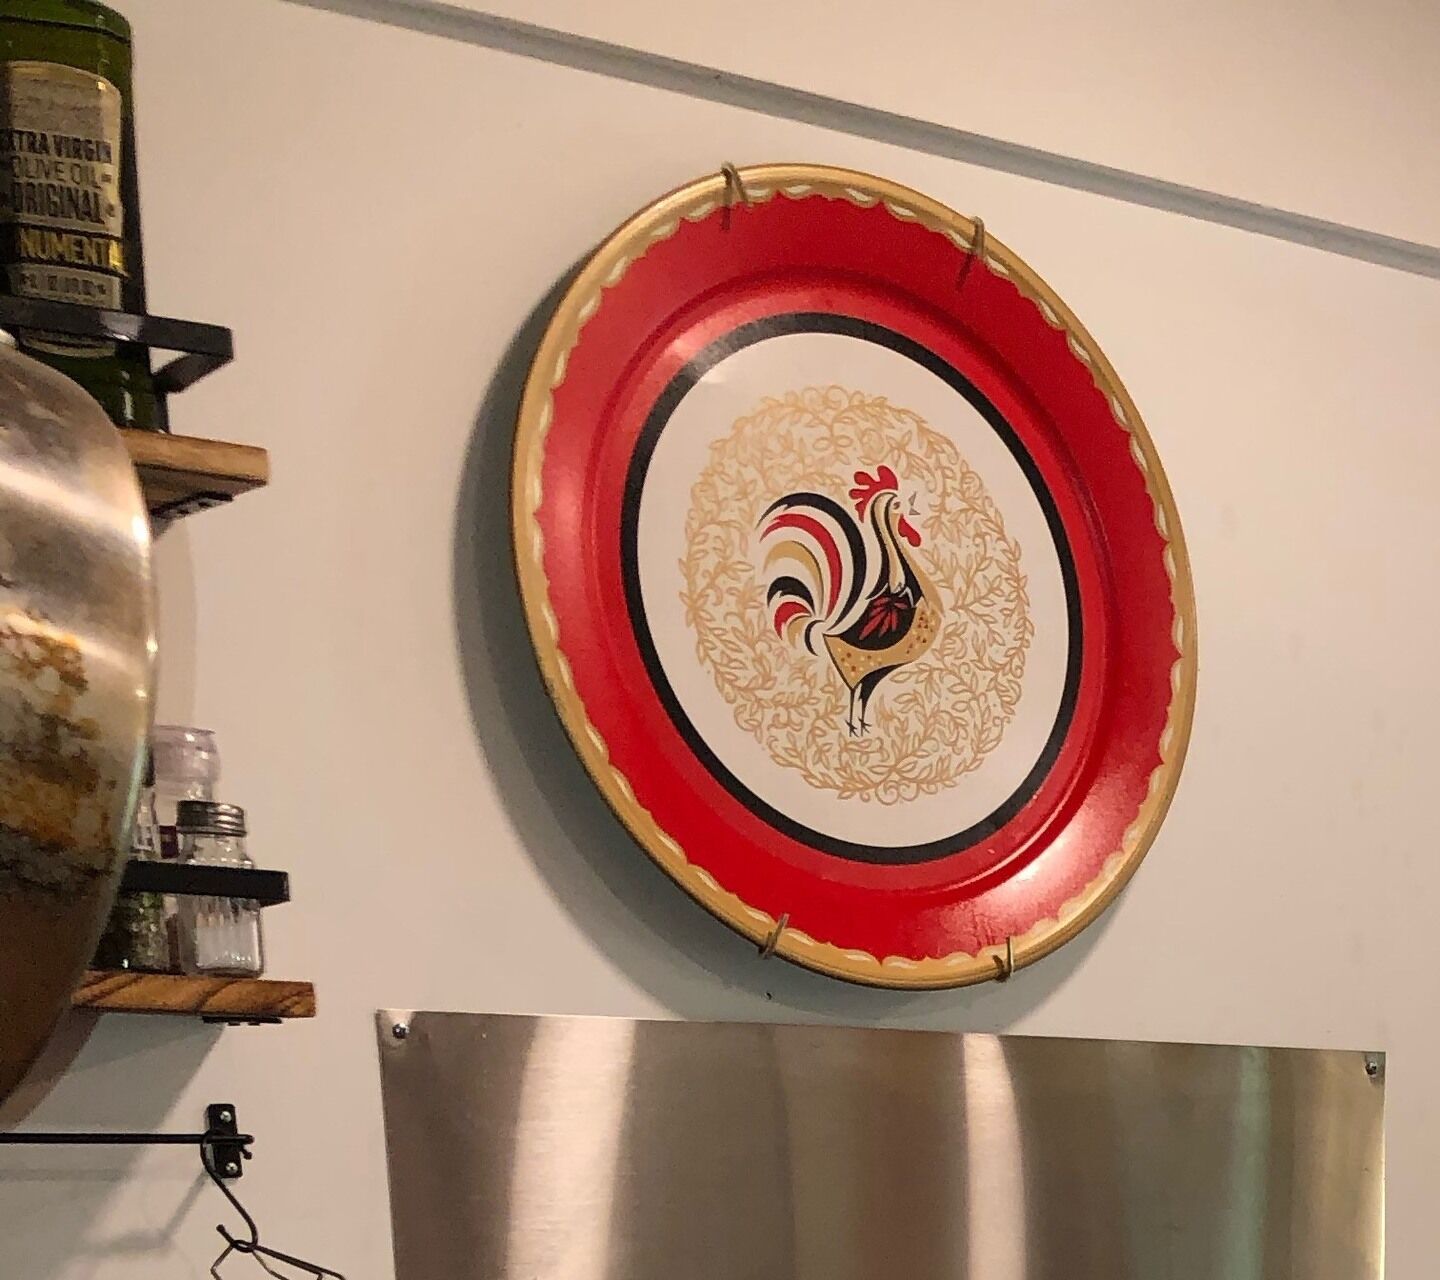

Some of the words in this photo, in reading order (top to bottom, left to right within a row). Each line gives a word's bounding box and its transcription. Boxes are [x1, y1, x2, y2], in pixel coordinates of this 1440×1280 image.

[1, 127, 50, 154] XTRA
[52, 134, 112, 163] VIRGIN
[9, 154, 65, 183] OLIVE
[70, 162, 101, 189] OIL
[9, 181, 105, 225] ORIGINAL
